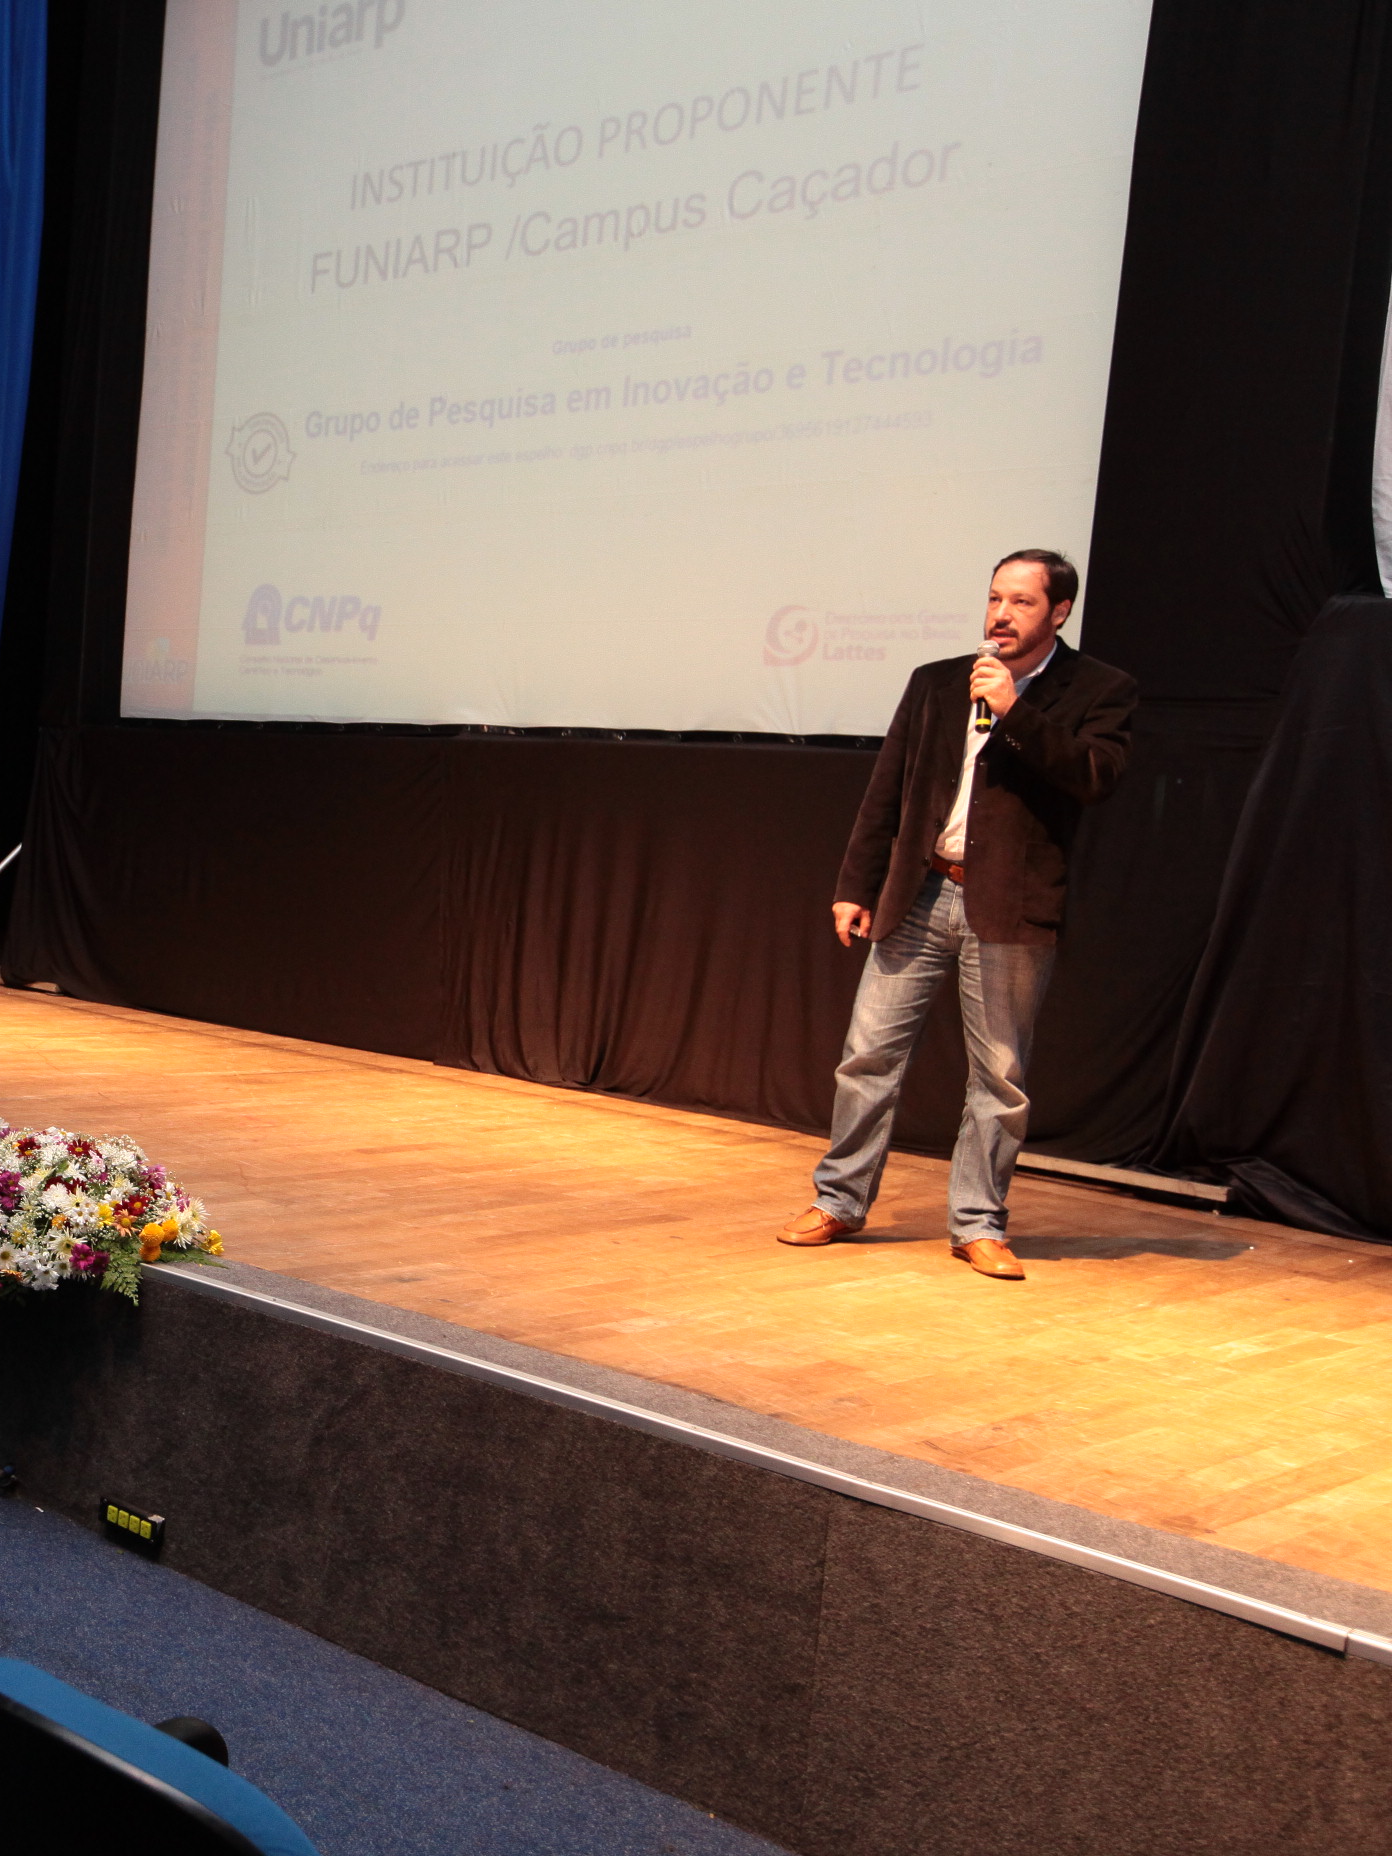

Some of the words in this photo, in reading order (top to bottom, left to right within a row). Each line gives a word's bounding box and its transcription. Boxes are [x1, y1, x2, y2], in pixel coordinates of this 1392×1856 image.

[259, 0, 406, 67] Uniarp
[349, 122, 584, 210] INSTITUIÇÃO
[596, 43, 925, 160] PROPONENTE
[310, 221, 493, 294] FUNIARP
[726, 140, 962, 220] Caçador
[305, 408, 381, 442] Grupo
[388, 401, 419, 431] de
[428, 387, 558, 429] Pesquisa
[566, 385, 612, 414] em
[621, 361, 775, 408] Inovação
[786, 363, 807, 390] e
[820, 328, 1046, 386] Tecnologia
[283, 594, 383, 642] CNPq
[822, 642, 887, 661] Lattes
